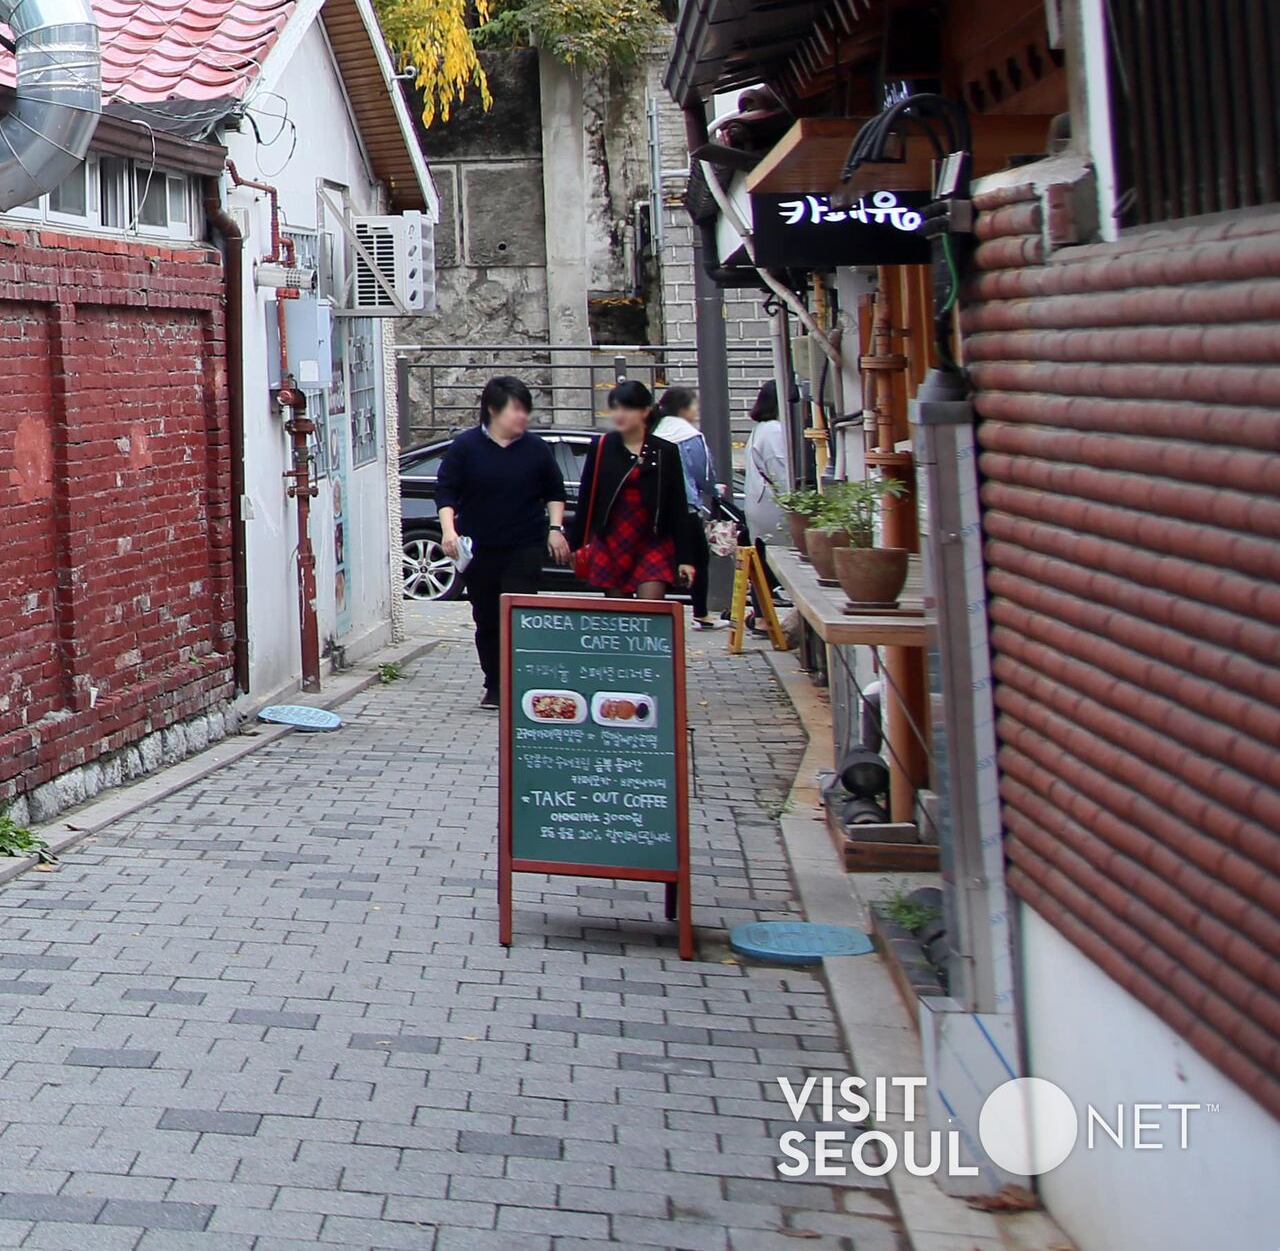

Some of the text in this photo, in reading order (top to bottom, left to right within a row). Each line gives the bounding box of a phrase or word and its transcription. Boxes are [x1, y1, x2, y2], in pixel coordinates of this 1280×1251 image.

[521, 614, 652, 632] KOREA DESSERT
[581, 635, 671, 653] CAFE YUNG
[530, 790, 576, 807] TAKE
[593, 791, 619, 805] OUT
[623, 793, 669, 809] COFFEE
